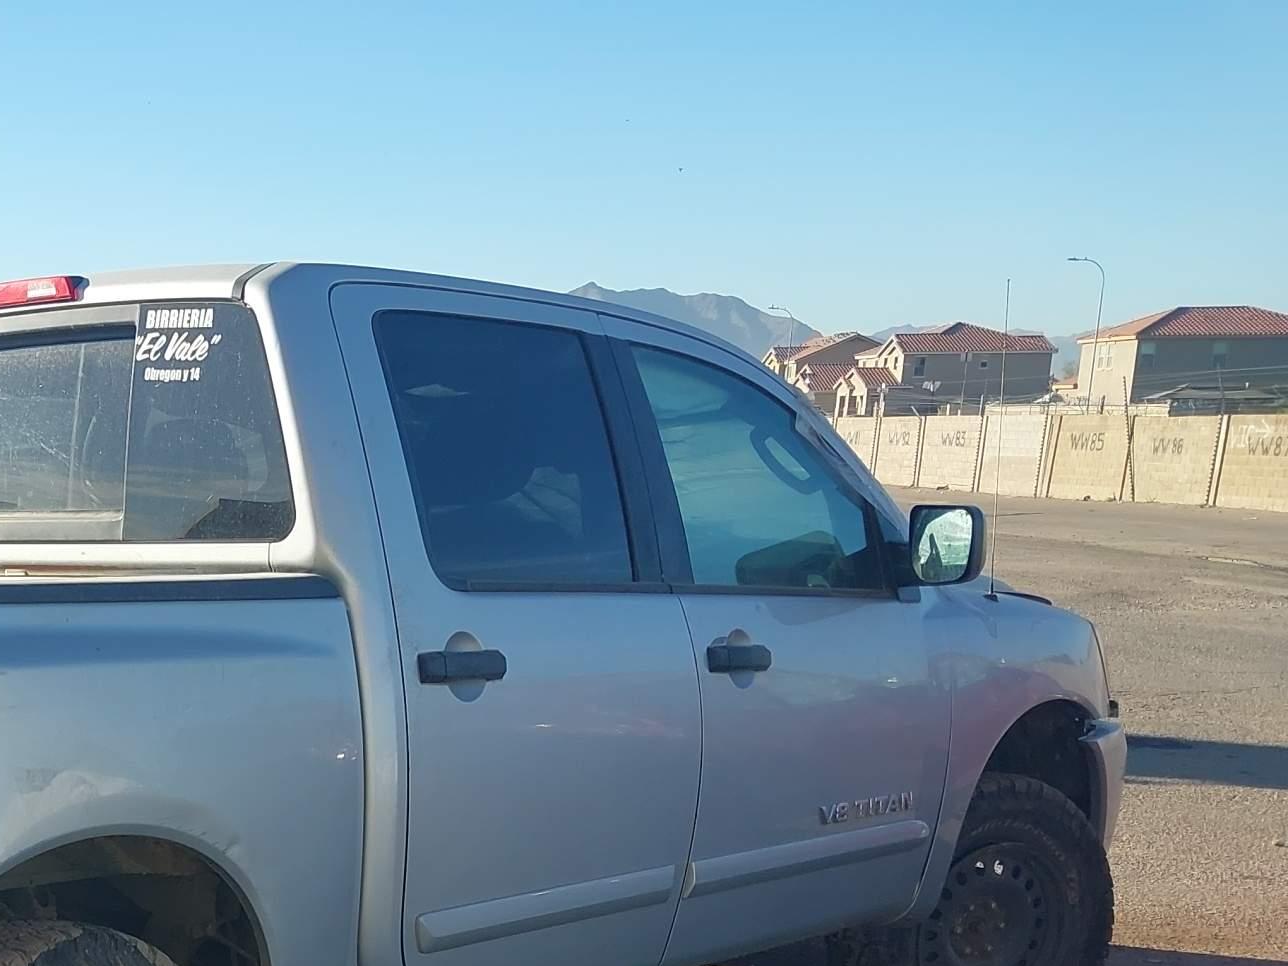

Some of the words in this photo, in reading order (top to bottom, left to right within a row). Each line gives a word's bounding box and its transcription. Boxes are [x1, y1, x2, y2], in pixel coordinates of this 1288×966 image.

[146, 308, 213, 328] BIRRIERIA
[164, 331, 222, 361] Vale"
[181, 370, 189, 382] y
[190, 367, 200, 381] 14
[1070, 432, 1106, 452] WW85
[854, 791, 914, 817] TITAN
